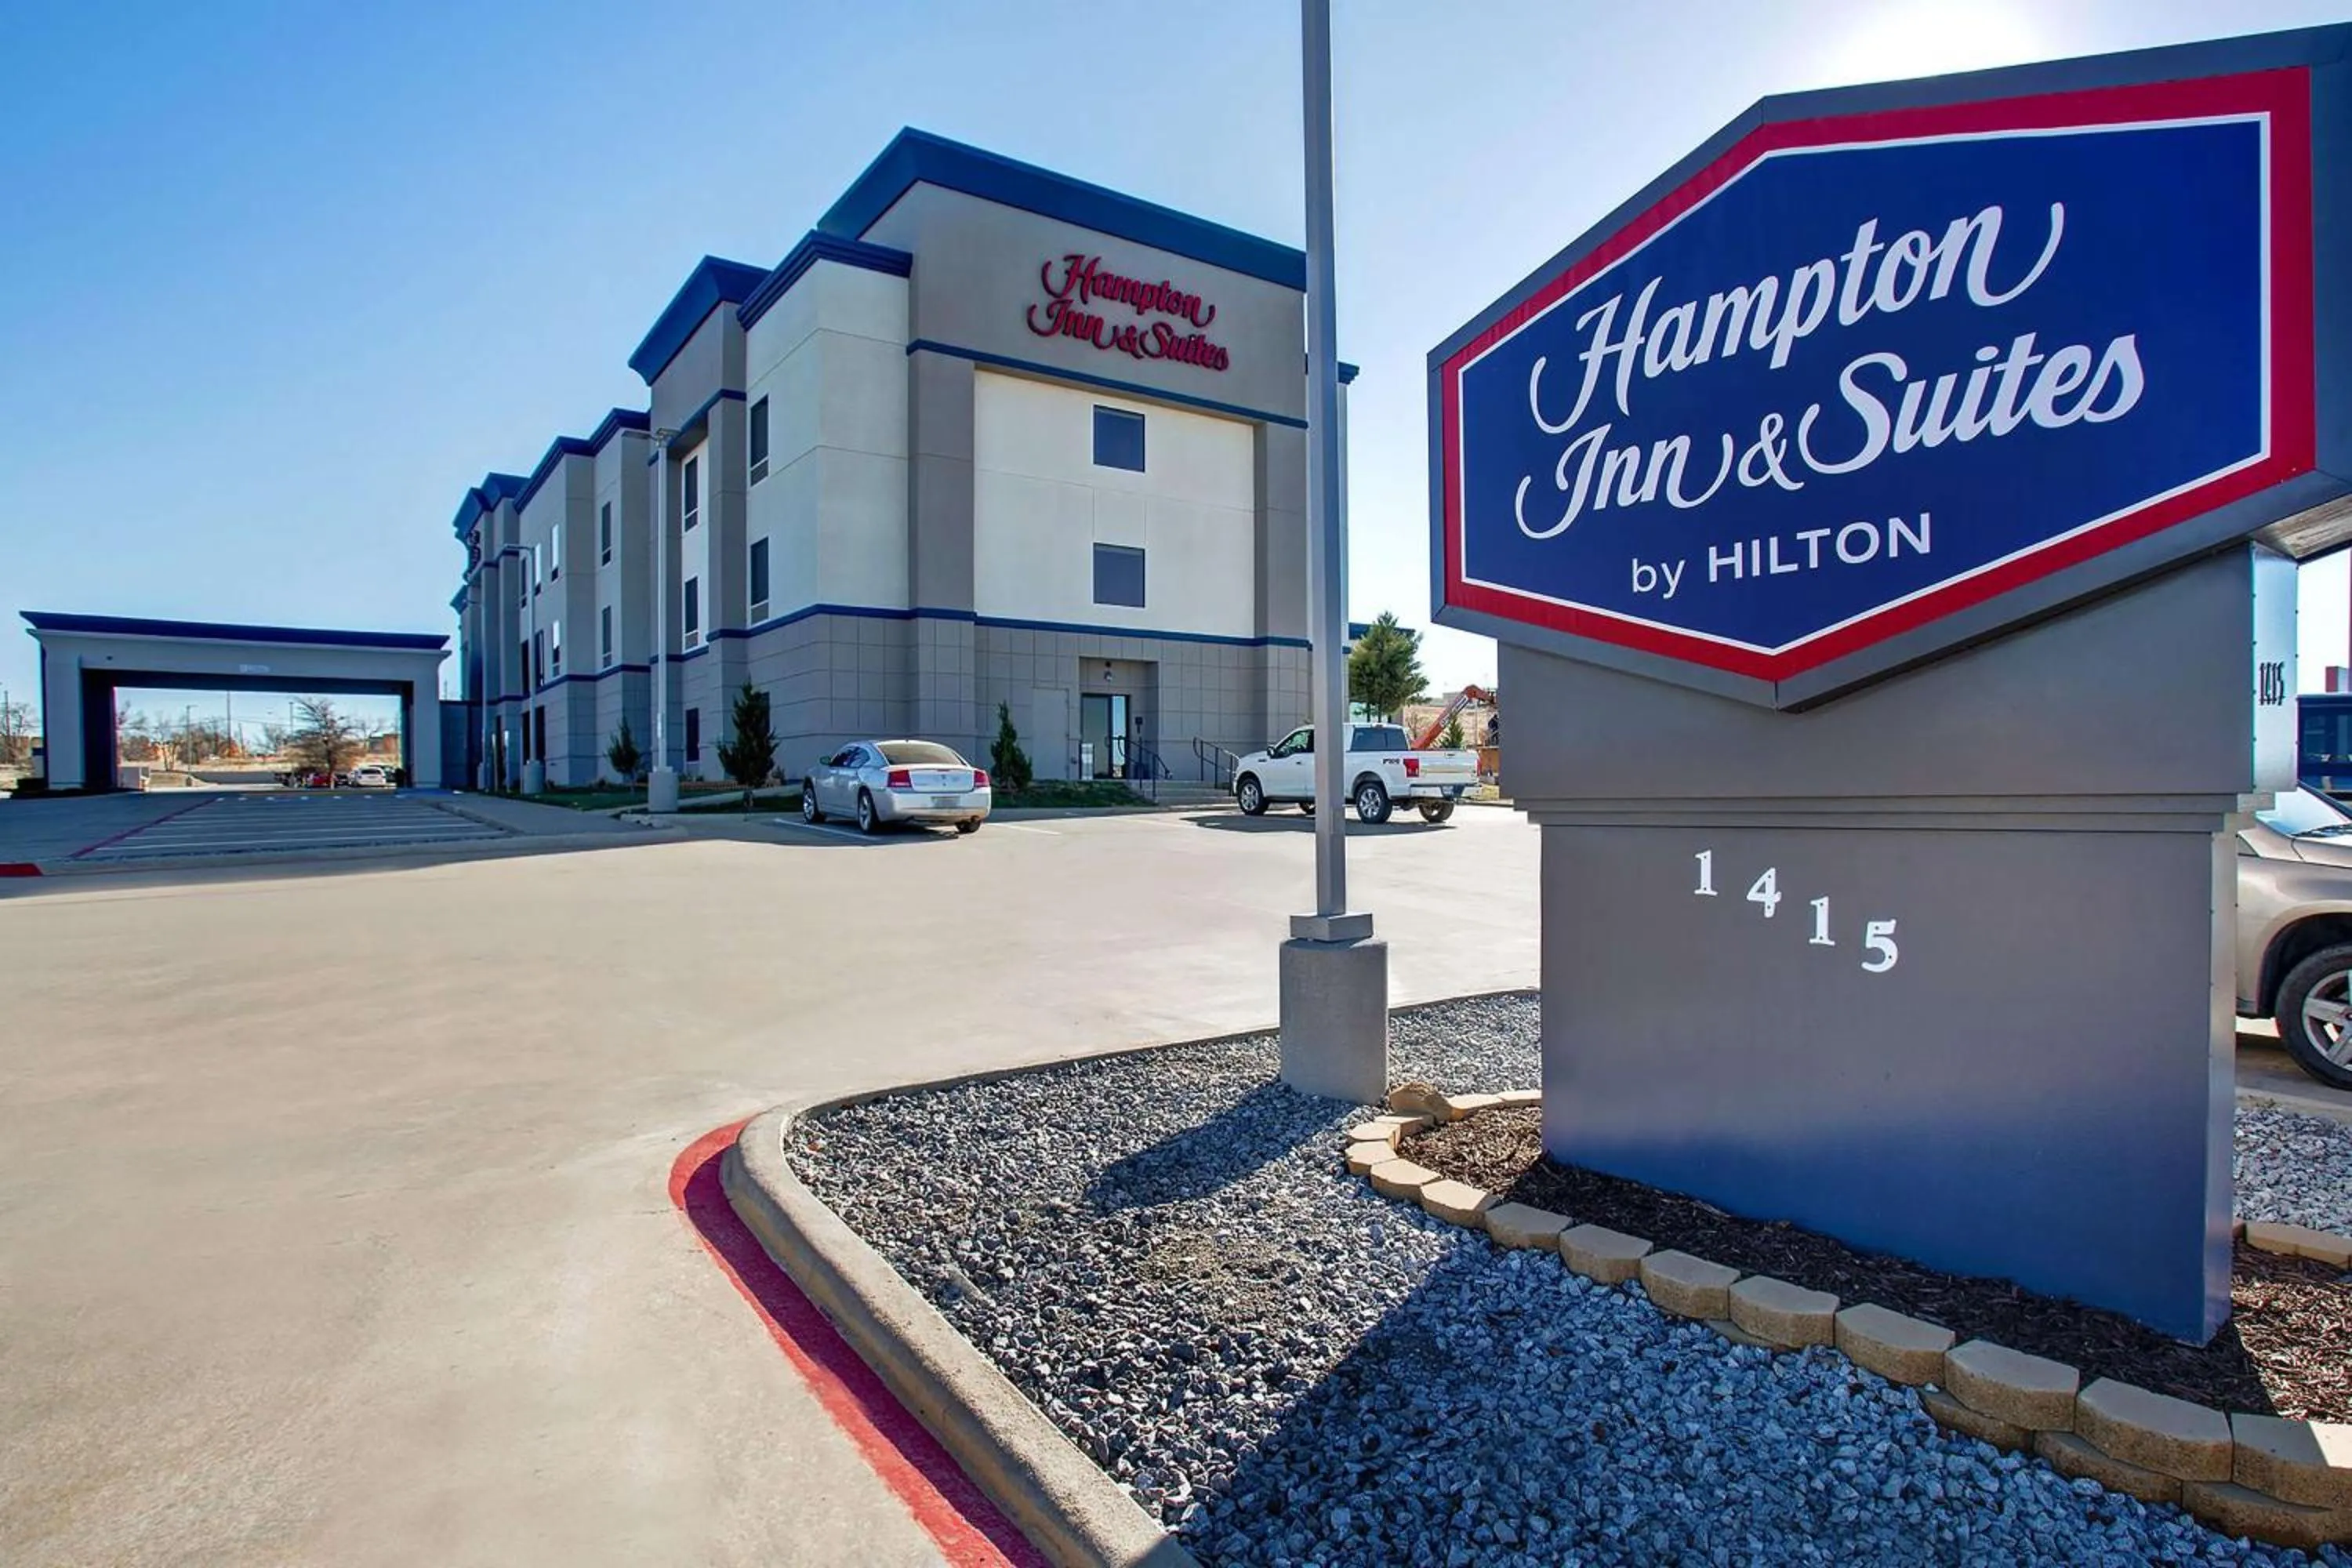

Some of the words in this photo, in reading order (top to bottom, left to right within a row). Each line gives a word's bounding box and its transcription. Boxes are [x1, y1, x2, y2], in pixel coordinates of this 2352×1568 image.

[1040, 254, 1216, 328] Hampton
[1530, 202, 2064, 434] Hampton
[1026, 298, 1119, 350] Inn
[1117, 325, 1143, 359] &
[1138, 321, 1230, 372] Suites
[1515, 423, 1733, 539] Inn
[1738, 413, 1805, 491] &
[1798, 332, 2145, 474] Suites
[1632, 558, 1686, 599] by
[1708, 512, 1931, 583] HILTON
